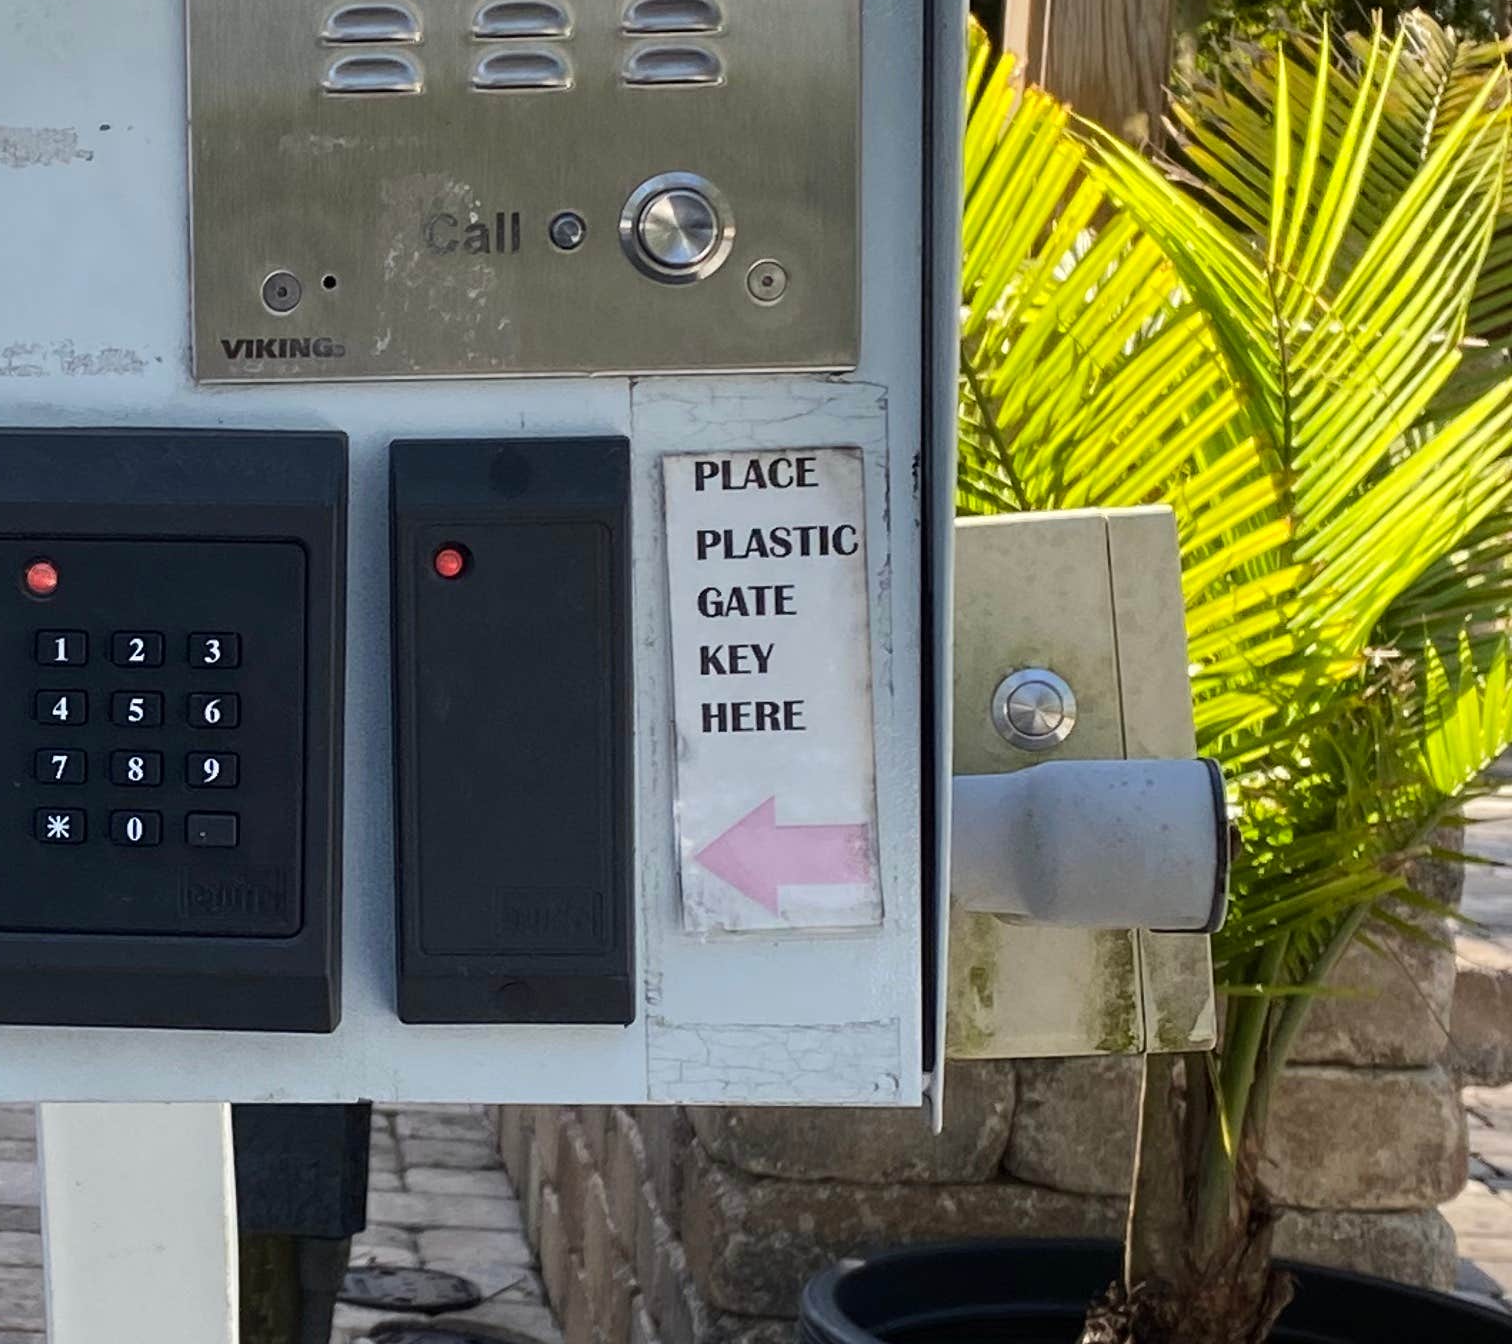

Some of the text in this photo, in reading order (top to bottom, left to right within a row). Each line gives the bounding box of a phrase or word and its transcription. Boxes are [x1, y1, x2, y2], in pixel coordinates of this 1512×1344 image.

[424, 211, 521, 255] Call
[221, 337, 336, 359] VIKING
[694, 457, 819, 492] PLACE
[697, 525, 858, 560] PLASTIC
[698, 585, 796, 618] GATE
[56, 638, 220, 663] 1 2 3
[700, 644, 774, 675] KEY
[53, 697, 220, 723] 4 5 6
[702, 700, 805, 732] HERE
[52, 756, 219, 782] 7 8 9
[127, 817, 142, 840] 0
